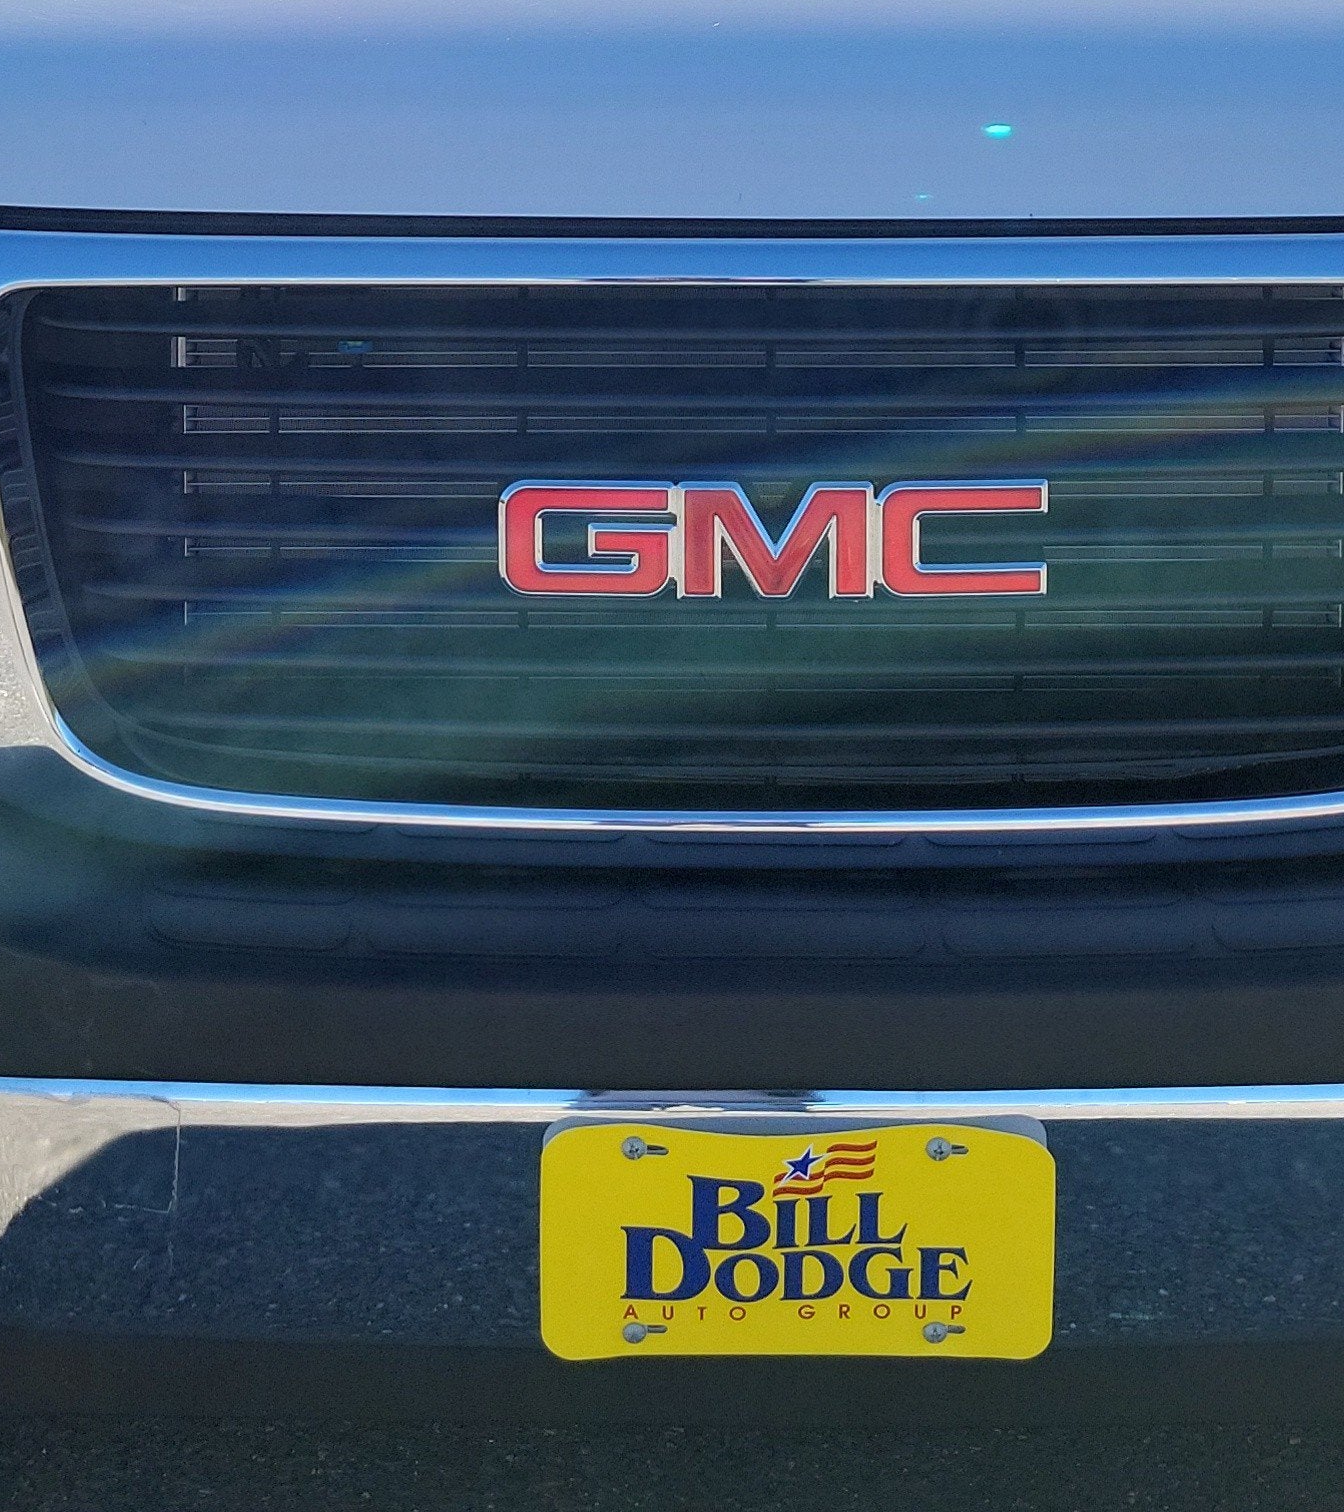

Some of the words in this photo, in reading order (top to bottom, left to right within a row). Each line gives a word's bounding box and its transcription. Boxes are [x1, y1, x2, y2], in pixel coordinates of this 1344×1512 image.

[497, 479, 1049, 600] GMC
[686, 1174, 909, 1251] BILL
[619, 1225, 973, 1302] DODGE
[622, 1303, 747, 1322] AUTO
[797, 1303, 964, 1322] GROUP
